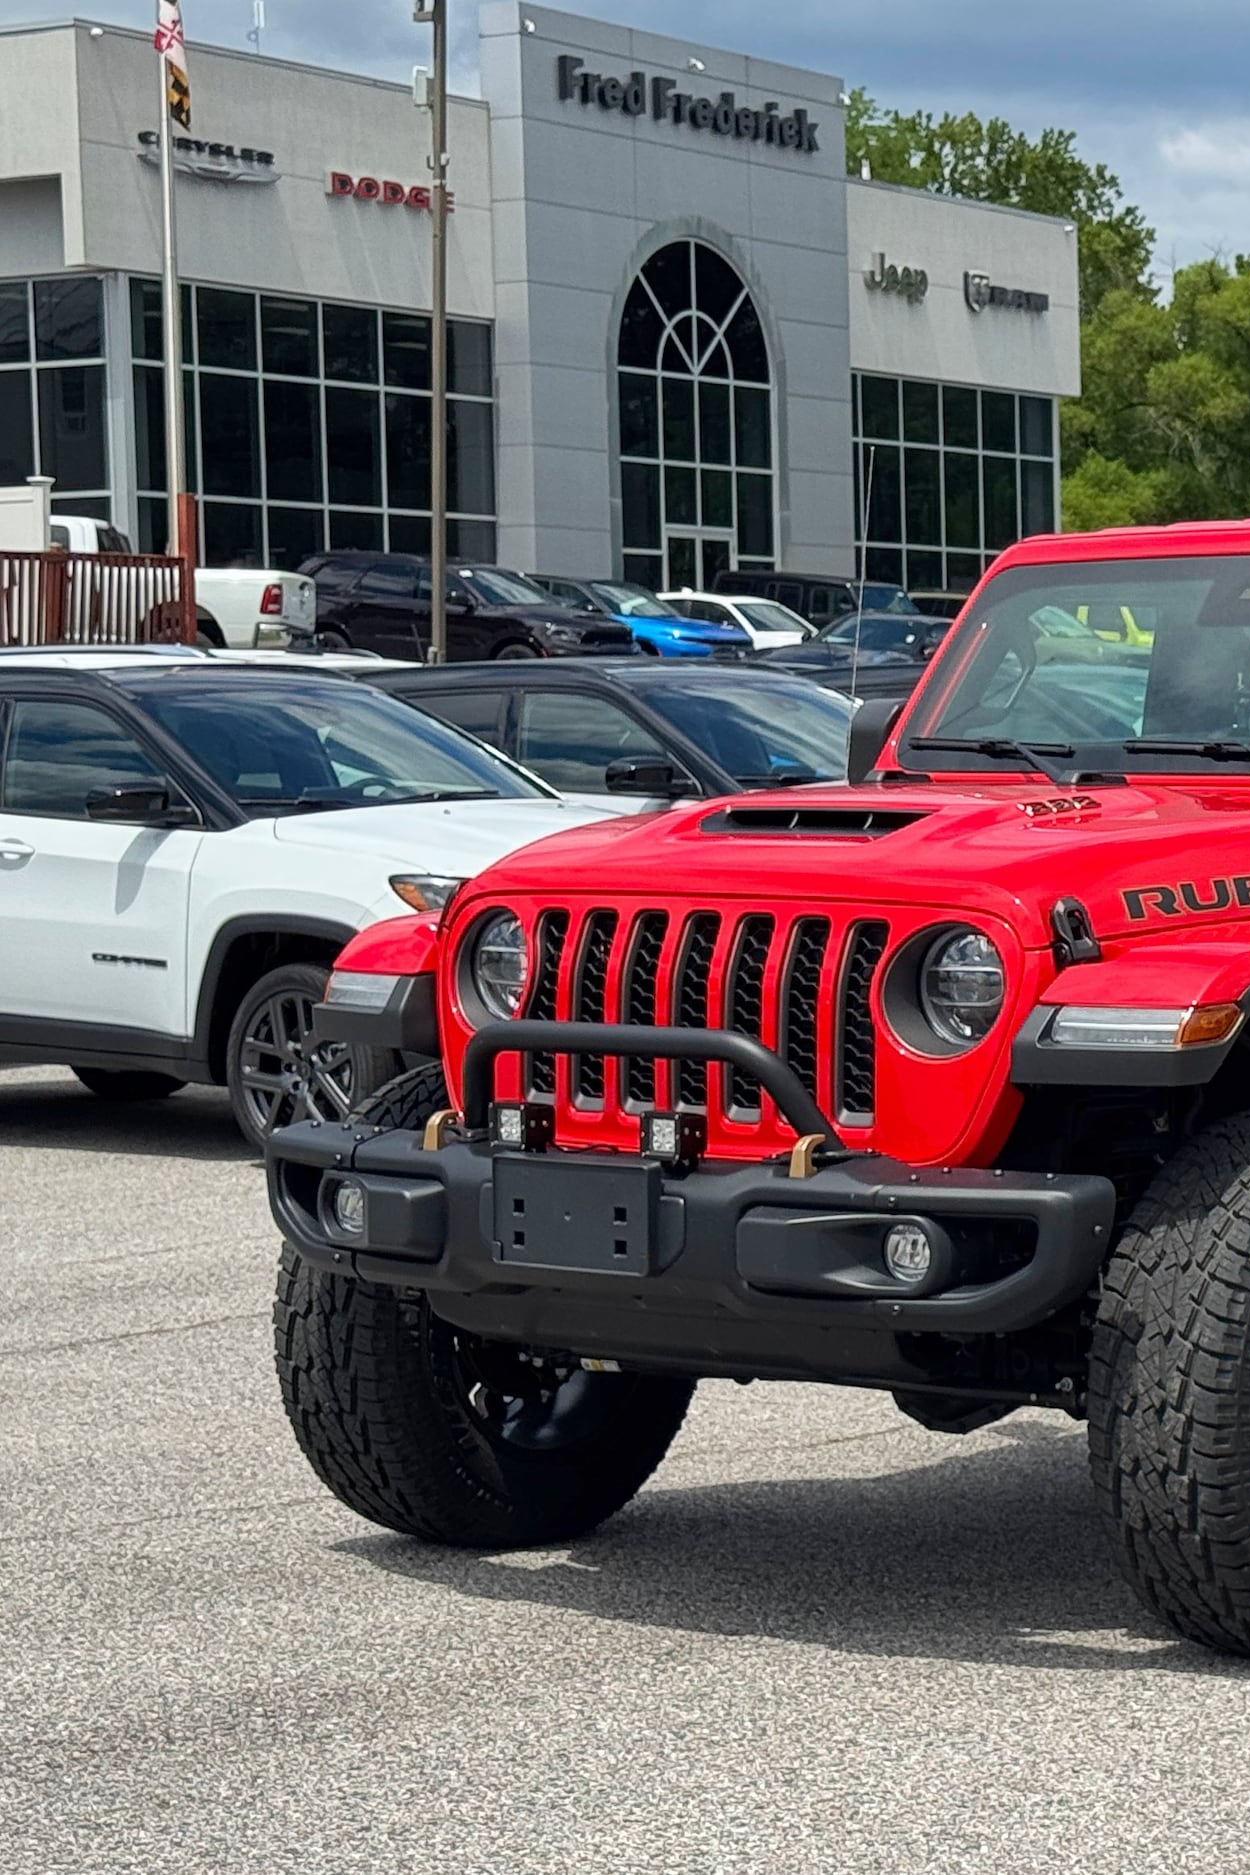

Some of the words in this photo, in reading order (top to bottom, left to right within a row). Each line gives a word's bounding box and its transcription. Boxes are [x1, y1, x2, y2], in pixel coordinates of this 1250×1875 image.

[558, 55, 646, 116] Fred
[652, 76, 820, 152] Frederick
[862, 252, 929, 304] Jeep
